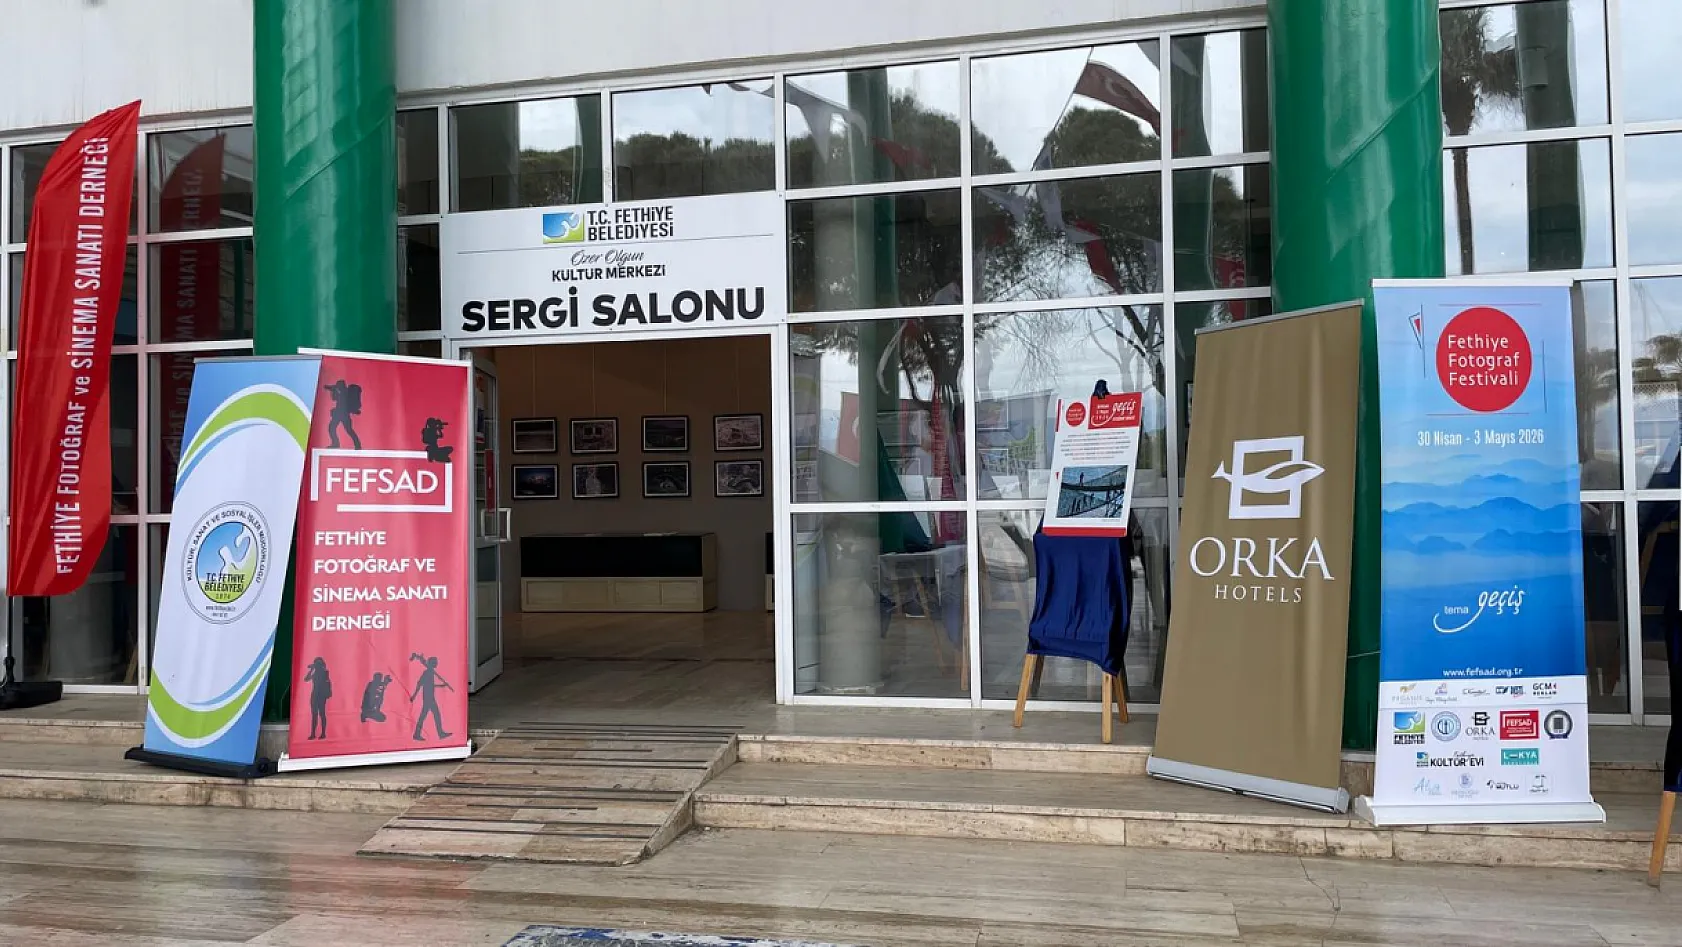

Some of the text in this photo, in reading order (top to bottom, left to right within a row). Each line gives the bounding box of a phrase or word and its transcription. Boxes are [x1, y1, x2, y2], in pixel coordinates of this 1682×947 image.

[587, 206, 674, 225] T.C. FETHİYE
[588, 222, 674, 241] BELEDİYESİ
[604, 248, 645, 266] Olgun
[461, 285, 765, 331] SERGİ SALONU
[1448, 333, 1509, 352] Fethiye
[51, 137, 109, 573] FETHİYE FOTOĞRAF ve SİNEMA SANATI DERNEĞİ
[1449, 370, 1519, 386] Festivali
[1417, 431, 1430, 446] 30
[1434, 430, 1462, 446] Nisan
[1474, 429, 1481, 445] 3
[1518, 428, 1545, 444] 2026
[325, 467, 439, 494] FEFSAD
[314, 527, 386, 546] FETHİYE
[313, 555, 436, 574] FOTOĞRAF VE
[1189, 536, 1335, 581] ORKA
[312, 583, 448, 603] SİNEMA SANATI
[1214, 584, 1303, 603] HOTELS
[1444, 605, 1469, 615] tema
[311, 610, 391, 631] DERNEĞİ
[1442, 666, 1523, 677] www.fefsad.org.tr
[1465, 726, 1496, 736] ORKA
[1506, 718, 1533, 727] FEFSAD
